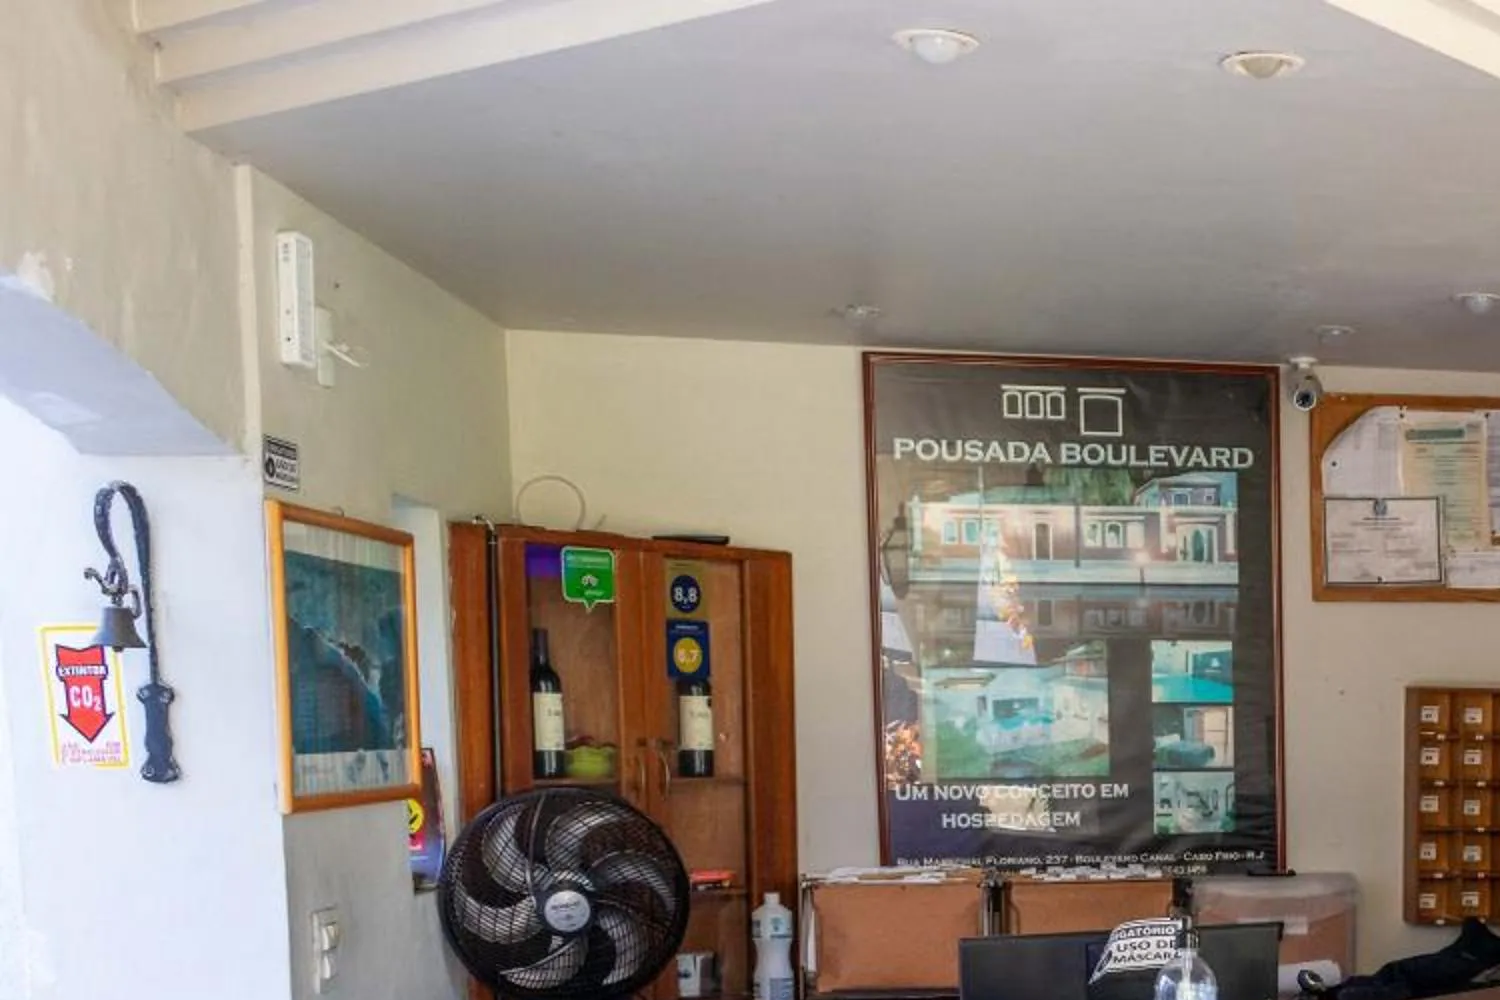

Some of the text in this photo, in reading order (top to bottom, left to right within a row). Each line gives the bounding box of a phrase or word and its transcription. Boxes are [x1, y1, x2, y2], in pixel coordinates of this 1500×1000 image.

[893, 438, 1255, 469] POUSADA BOULEVARD
[674, 586, 698, 604] 8,8
[895, 783, 1129, 801] UM NOVO CONCEITO EM
[941, 811, 1082, 829] HOSPEDAGEM
[1117, 941, 1151, 953] USO
